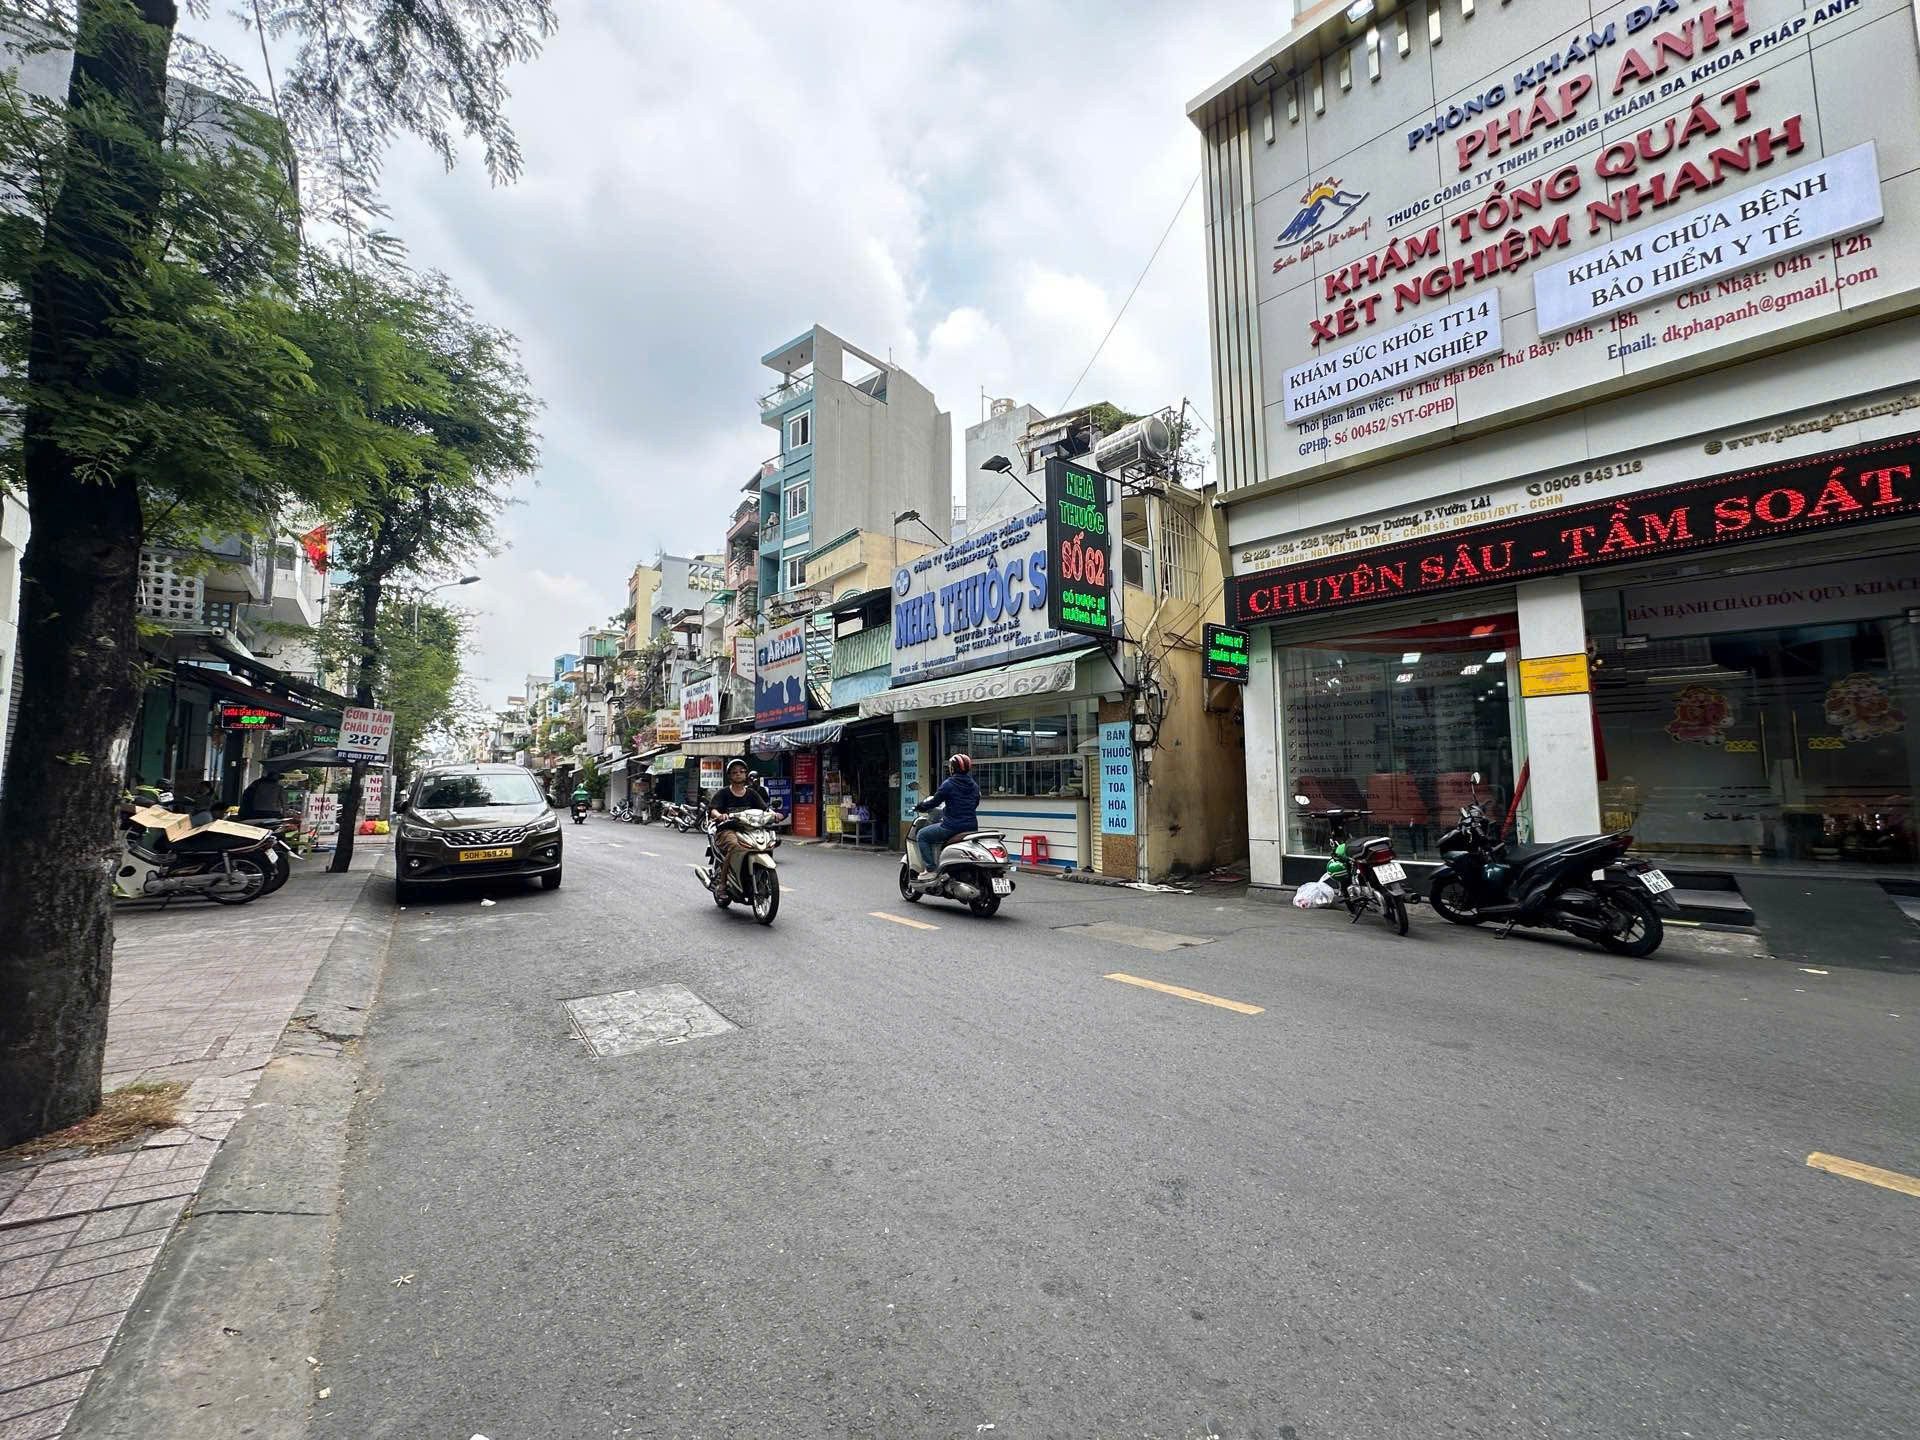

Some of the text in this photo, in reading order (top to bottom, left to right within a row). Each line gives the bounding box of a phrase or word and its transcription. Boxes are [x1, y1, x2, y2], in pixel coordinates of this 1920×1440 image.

[1386, 199, 1430, 228] THUỘC
[1433, 180, 1471, 205] CÔNG
[1475, 168, 1493, 185] TY
[1496, 148, 1538, 175] TNHH
[1542, 117, 1599, 153] PHÒNG
[1603, 90, 1654, 124] KHÁM
[1659, 77, 1685, 98] ĐA
[1690, 49, 1743, 82] KHOA
[1749, 18, 1806, 56] PHÁP
[1407, 84, 1506, 151] PHÒNG
[1513, 22, 1617, 98] KHÁM
[1456, 0, 1749, 170] PHÁP ANH
[1309, 114, 1804, 347] XÉT NGHIỆM NHANH
[1323, 80, 1758, 302] KHÁM TỔNG QUÁT
[1566, 172, 1828, 286] KHÁM CHỮA BỆNH
[1590, 208, 1802, 308] BẢO HIỂM Y TẾ
[1290, 301, 1490, 390] KHÁM SỨC KHỎE TT14
[1297, 418, 1320, 436] Thời
[1321, 411, 1344, 431] gian
[1346, 403, 1367, 421] làm
[1368, 396, 1395, 413] việc:
[1416, 377, 1441, 398] Thứ
[1443, 371, 1466, 389] Hai
[1468, 358, 1495, 381] Đến
[1498, 347, 1526, 370] Thứ
[1528, 340, 1561, 361] Bảy:
[1563, 326, 1592, 347] 04h
[1608, 311, 1638, 332] 18h
[1676, 288, 1710, 310] Chủ
[1717, 271, 1765, 297] Nhật:
[1772, 253, 1811, 279] 04h
[1834, 236, 1871, 259] 12h
[1608, 267, 1877, 360] Email: dkphapanh@gmail.com
[1293, 329, 1489, 412] KHÁM DOANH NGHIỆP
[1297, 396, 1455, 457] GPHĐ: Số 00452/SYT-GPHĐ
[1058, 500, 1105, 535] THUỐC
[1066, 471, 1096, 503] NHÀ
[1061, 531, 1105, 587] SỐ 62
[1248, 464, 1912, 614] CHUYÊN SÂU TẦM SOÁT
[768, 636, 802, 664] AROMA
[884, 675, 1046, 713] NHÀ THUỐC 62
[348, 733, 382, 746] 287
[1105, 765, 1128, 776] THEO
[1108, 782, 1126, 793] TOA
